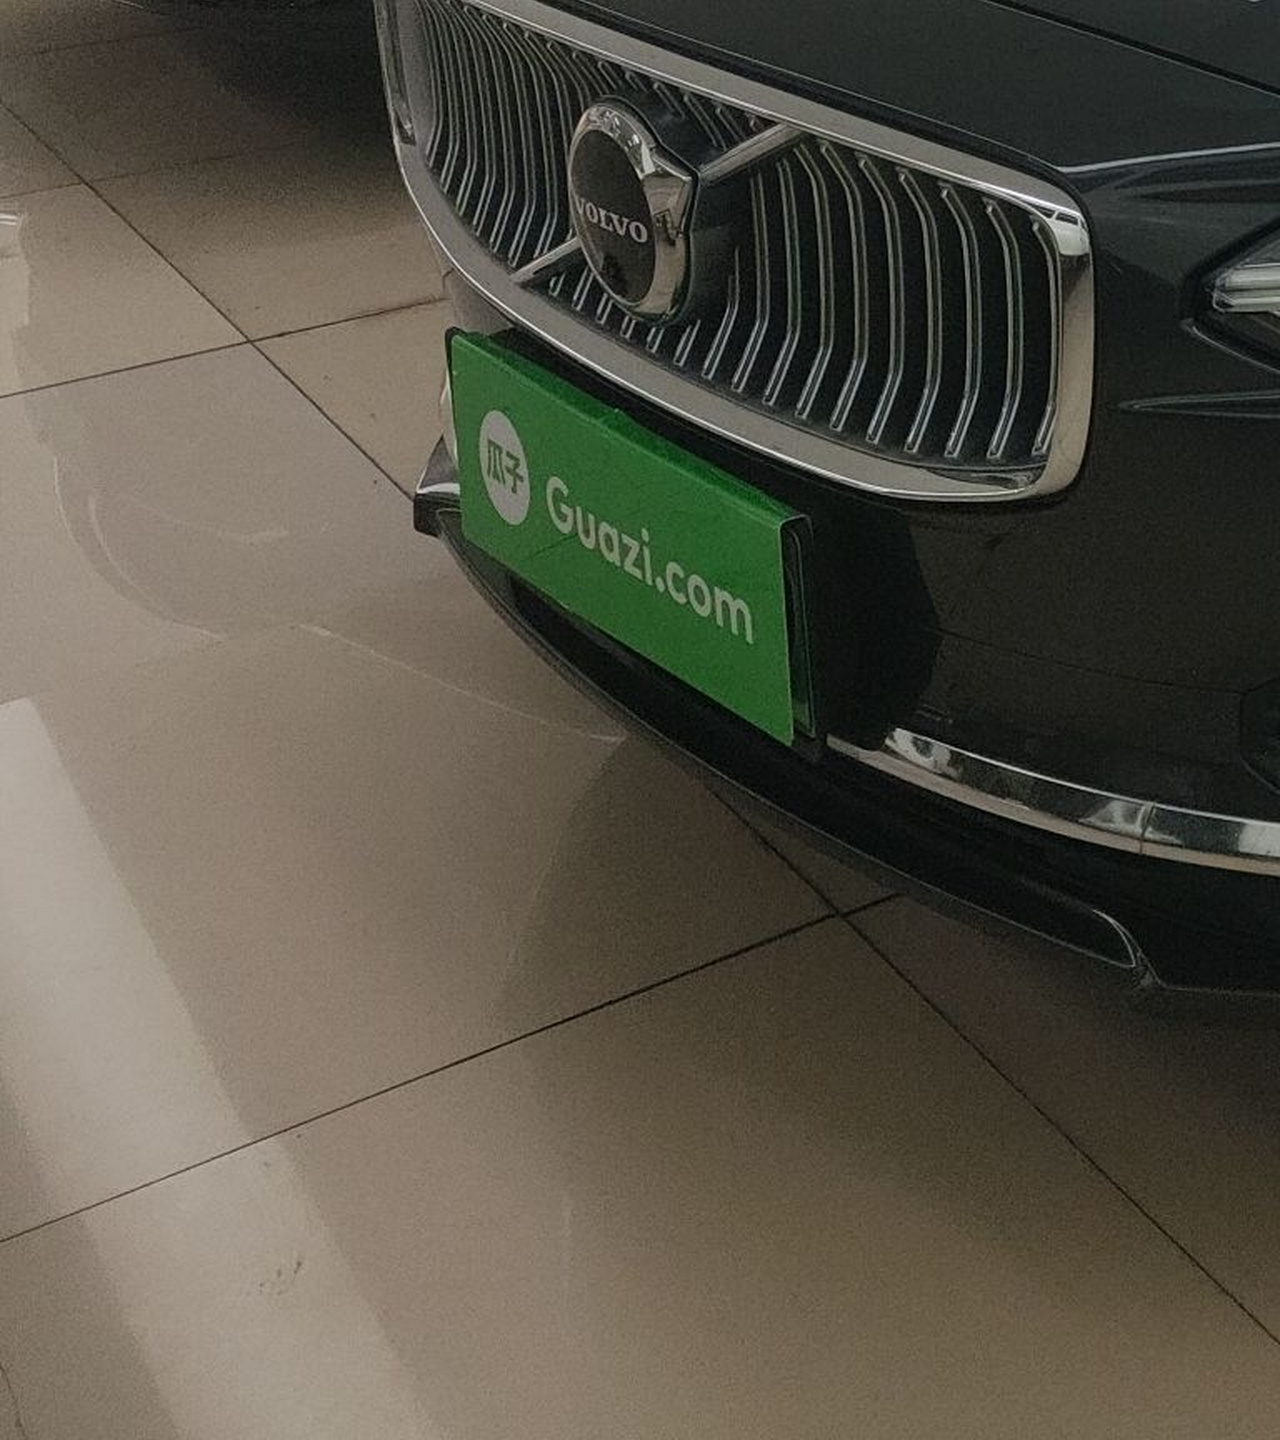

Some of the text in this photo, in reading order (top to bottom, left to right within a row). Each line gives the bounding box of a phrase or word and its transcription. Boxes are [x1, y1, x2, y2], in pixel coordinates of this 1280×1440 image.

[576, 196, 649, 244] VOLVO
[485, 438, 525, 494] 瓜子
[545, 476, 754, 645] Guazi.com
